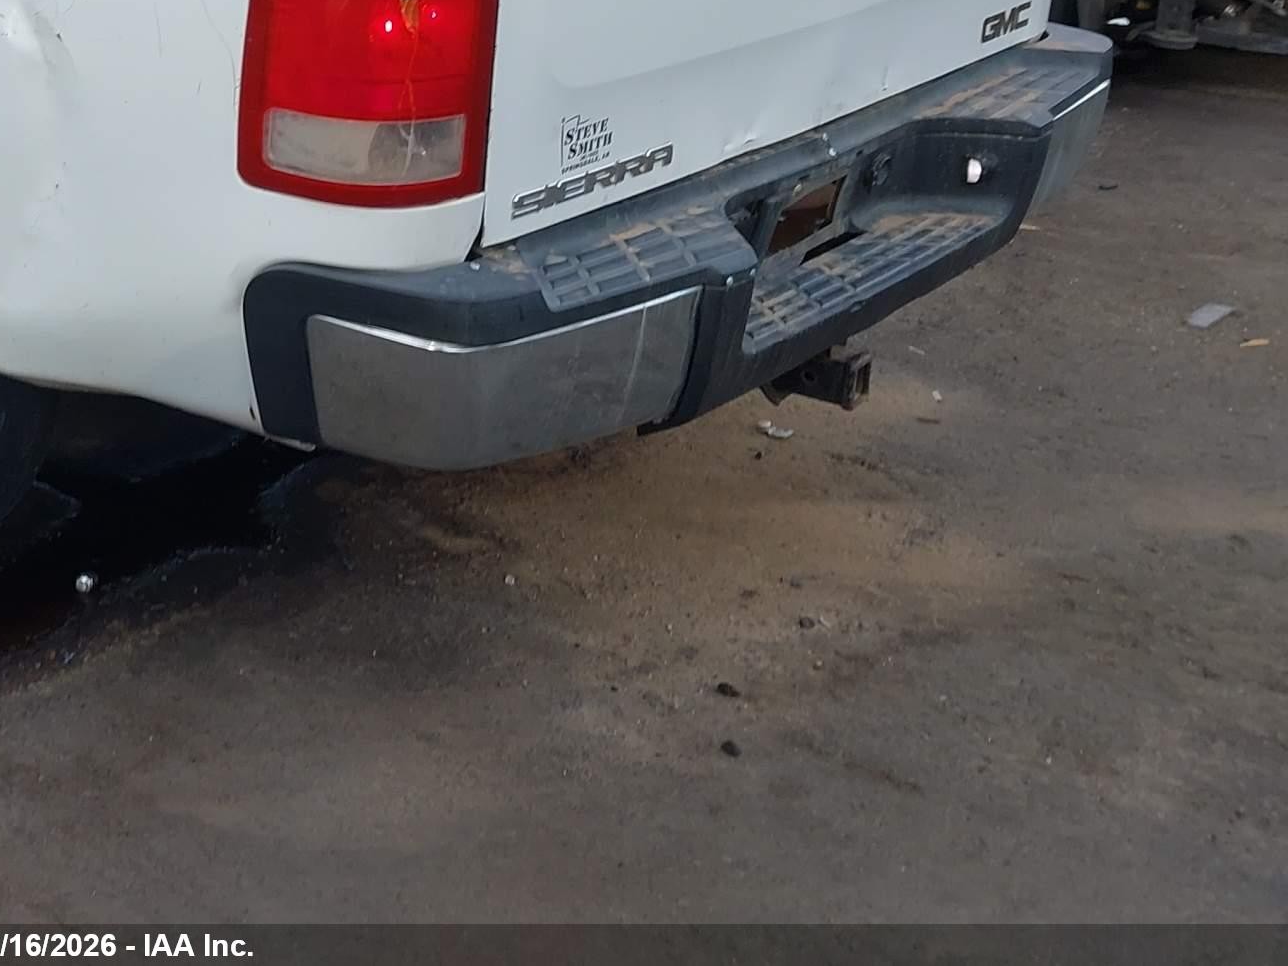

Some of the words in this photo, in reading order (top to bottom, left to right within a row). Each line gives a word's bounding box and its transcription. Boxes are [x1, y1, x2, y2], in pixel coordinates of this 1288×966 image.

[981, 1, 1032, 43] GMC
[564, 118, 608, 146] STEVE
[568, 132, 613, 160] SMITH
[511, 140, 673, 219] SIERRA
